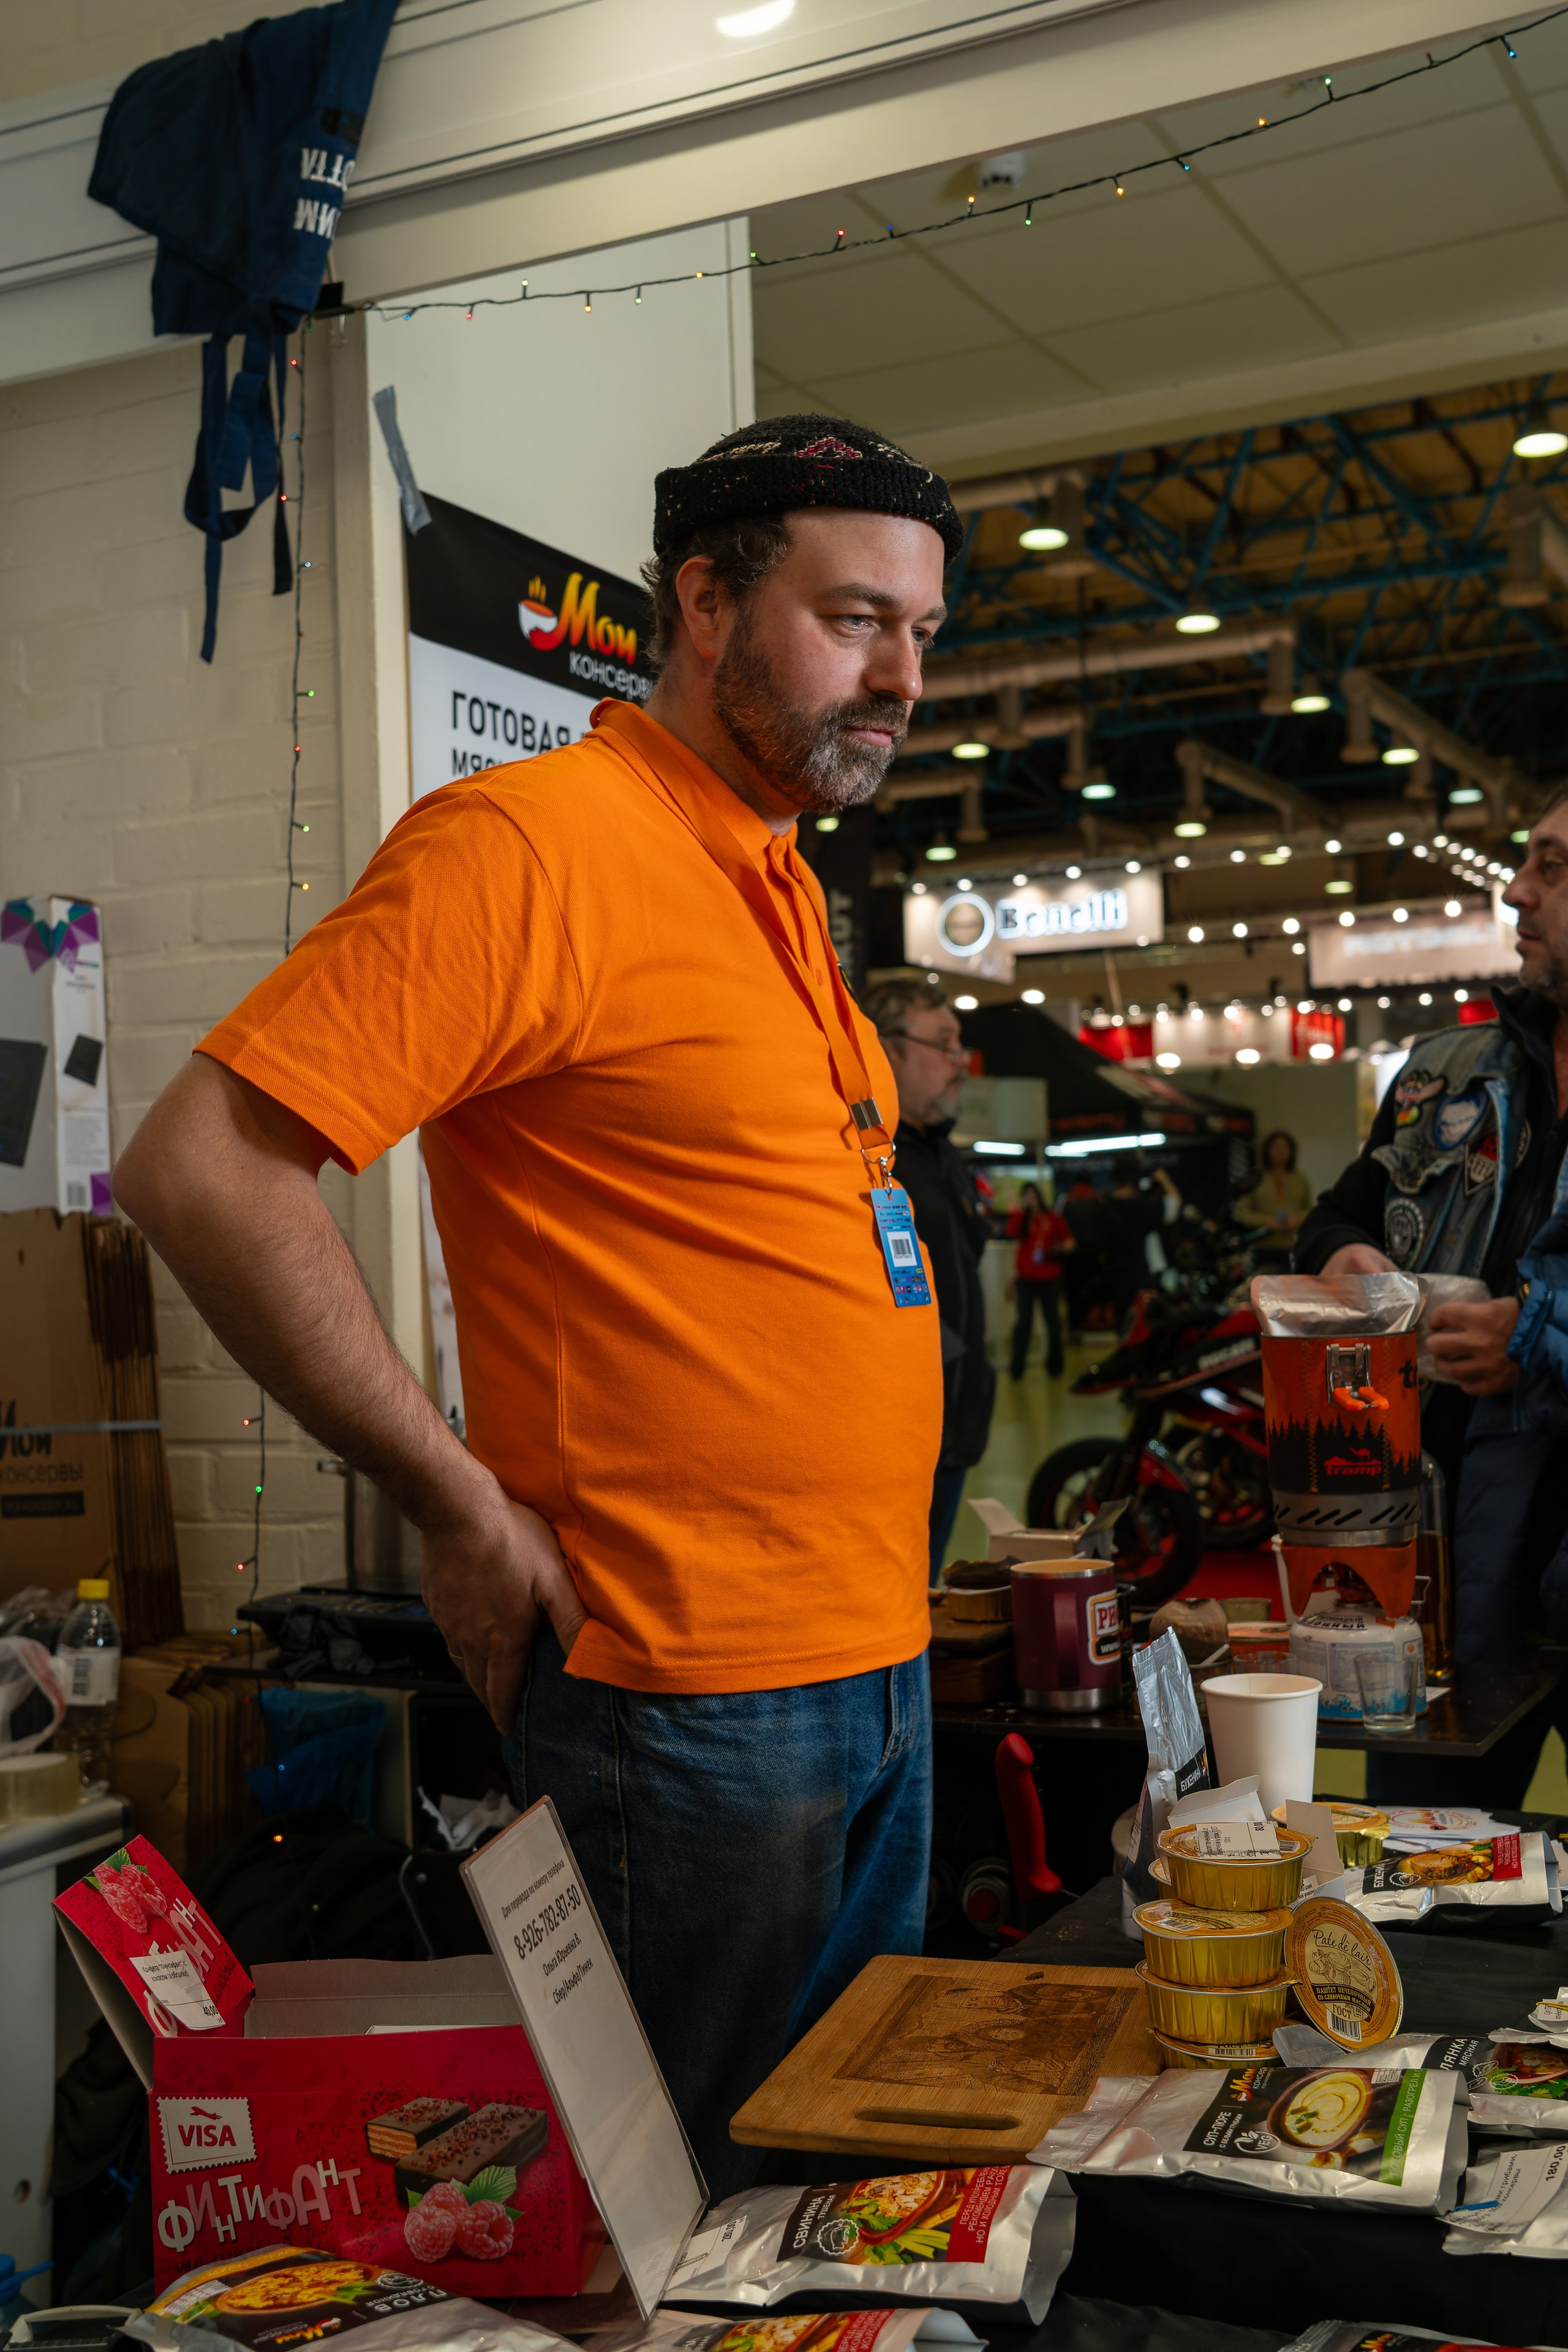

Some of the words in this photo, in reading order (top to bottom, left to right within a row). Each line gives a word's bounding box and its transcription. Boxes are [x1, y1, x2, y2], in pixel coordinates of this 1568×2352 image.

[530, 572, 638, 665] Мои
[451, 690, 570, 755] ГОТОВАЯ
[997, 888, 1127, 940] Benelli
[1324, 1464, 1383, 1477] tramp
[1181, 1767, 1202, 1792] БУЖЕНИНА
[502, 1905, 512, 1920] Для
[510, 1889, 530, 1911] перевода
[529, 1885, 535, 1895] по
[533, 1873, 549, 1891] номеру
[547, 1860, 565, 1879] телефона
[514, 1883, 581, 1960] 8-926-782-87-50
[543, 1956, 559, 1977] Ольга
[556, 1939, 577, 1963] Юрьевна
[1311, 1929, 1337, 1947] Pate
[1352, 1946, 1371, 1967] lair
[203, 2006, 218, 2016] 40,00
[1332, 2003, 1351, 2019] ГОСТ
[1338, 1986, 1371, 2006] ПЕЧЕНОЧНЫЙ
[1352, 1997, 1371, 2011] МАСЛОМ
[1458, 2040, 1479, 2067] МЯСНАЯ
[1398, 2117, 1408, 2132] СУП
[1403, 2077, 1419, 2112] РАЗОГРЕЛ
[177, 2124, 237, 2147] VISA
[1203, 2111, 1232, 2146] СУП-ПЮРЕ
[1221, 2128, 1234, 2144] БЕЛЫМИ
[1231, 2113, 1243, 2130] ГРИБАМИ
[1255, 2135, 1272, 2150] VEG
[1545, 2146, 1566, 2181] 180,00
[1502, 2168, 1521, 2202] консервы
[157, 2158, 362, 2253] ФИНТИФАНТ
[818, 2195, 837, 2219] ТУШЕНАЯ
[960, 2204, 974, 2225] ПЕРЕД
[968, 2187, 990, 2232] РЕКОМЕНДУЕМ
[976, 2229, 986, 2244] НО
[982, 2187, 1001, 2220] ХОЛОДНЫМ
[721, 2221, 737, 2242] 280,00
[793, 2196, 825, 2248] СВИНИНА
[366, 2287, 427, 2308] ГОВЯДИНОЙ
[375, 2290, 448, 2313] ПЛОВ
